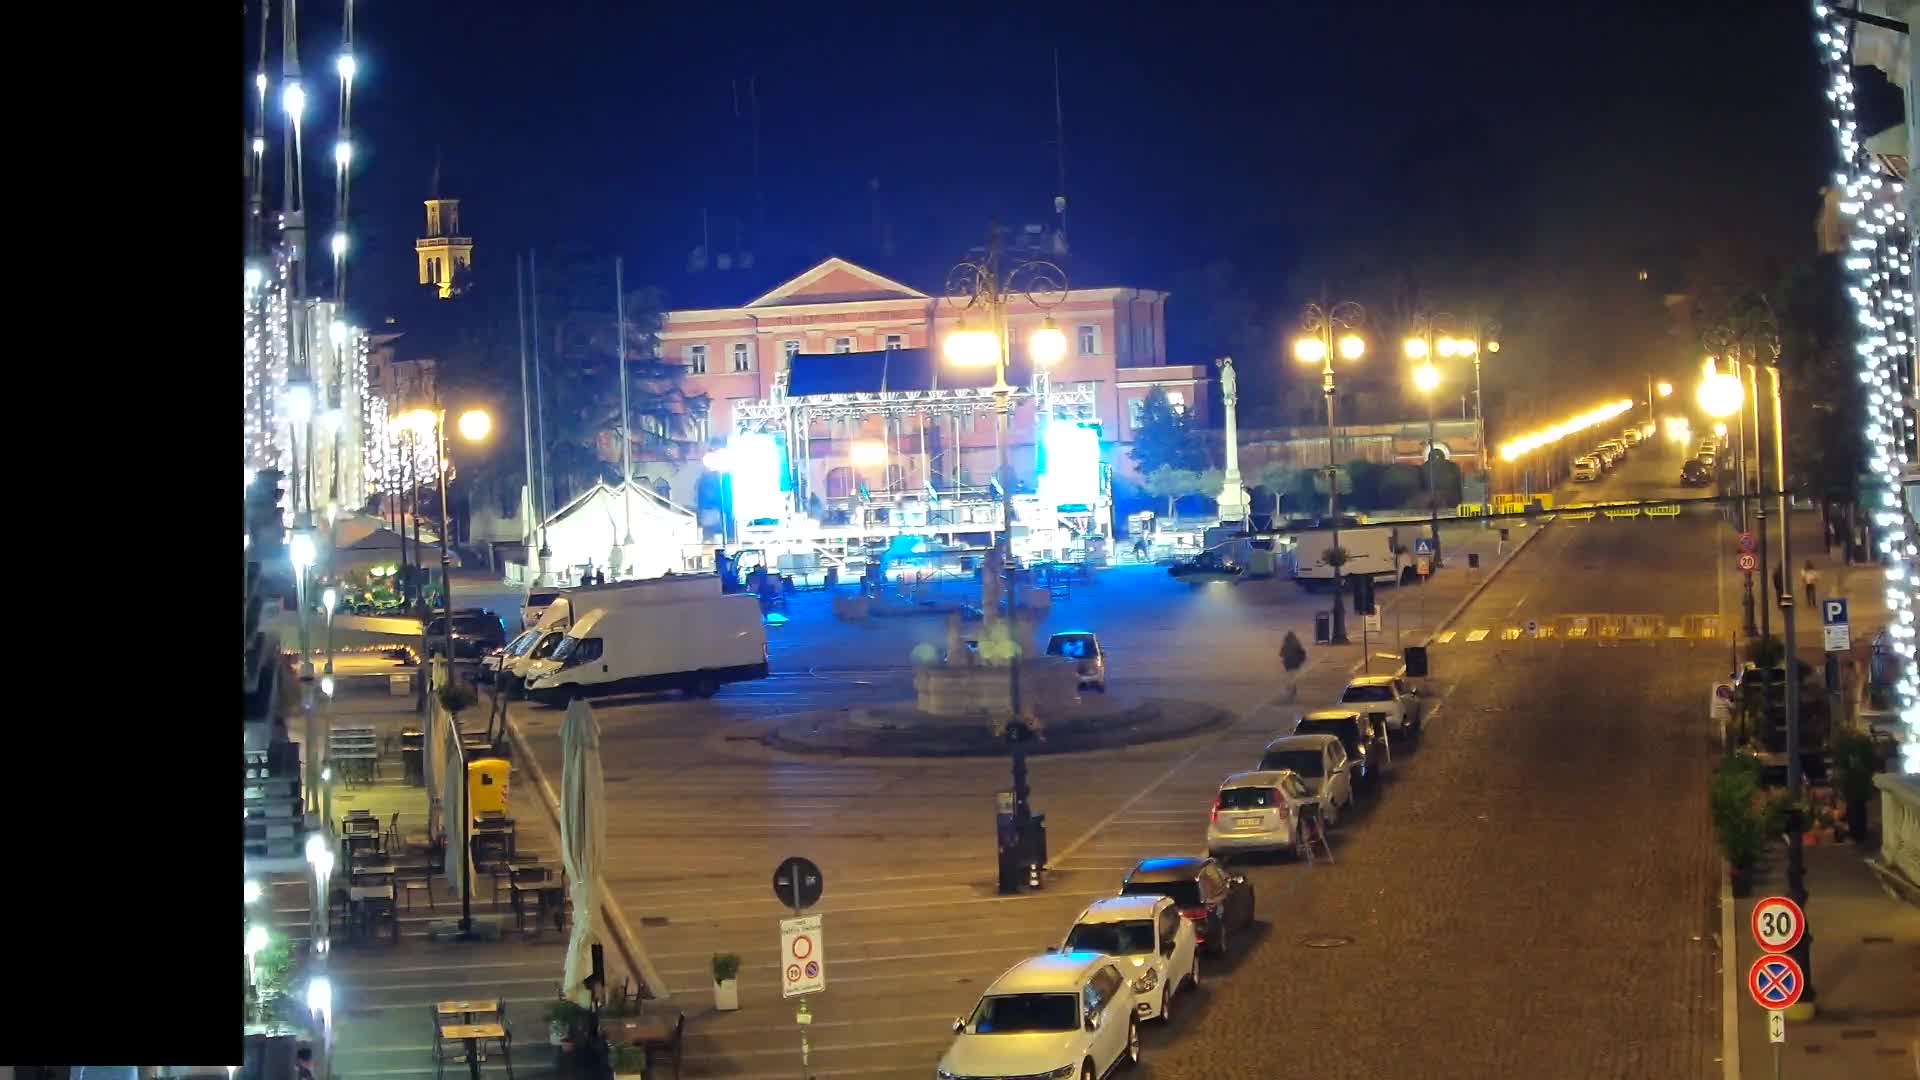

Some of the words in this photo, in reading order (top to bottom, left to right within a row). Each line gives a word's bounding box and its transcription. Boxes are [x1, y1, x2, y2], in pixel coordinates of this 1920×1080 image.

[1743, 557, 1753, 567] 20
[1828, 602, 1842, 621] P
[1763, 912, 1791, 937] 30
